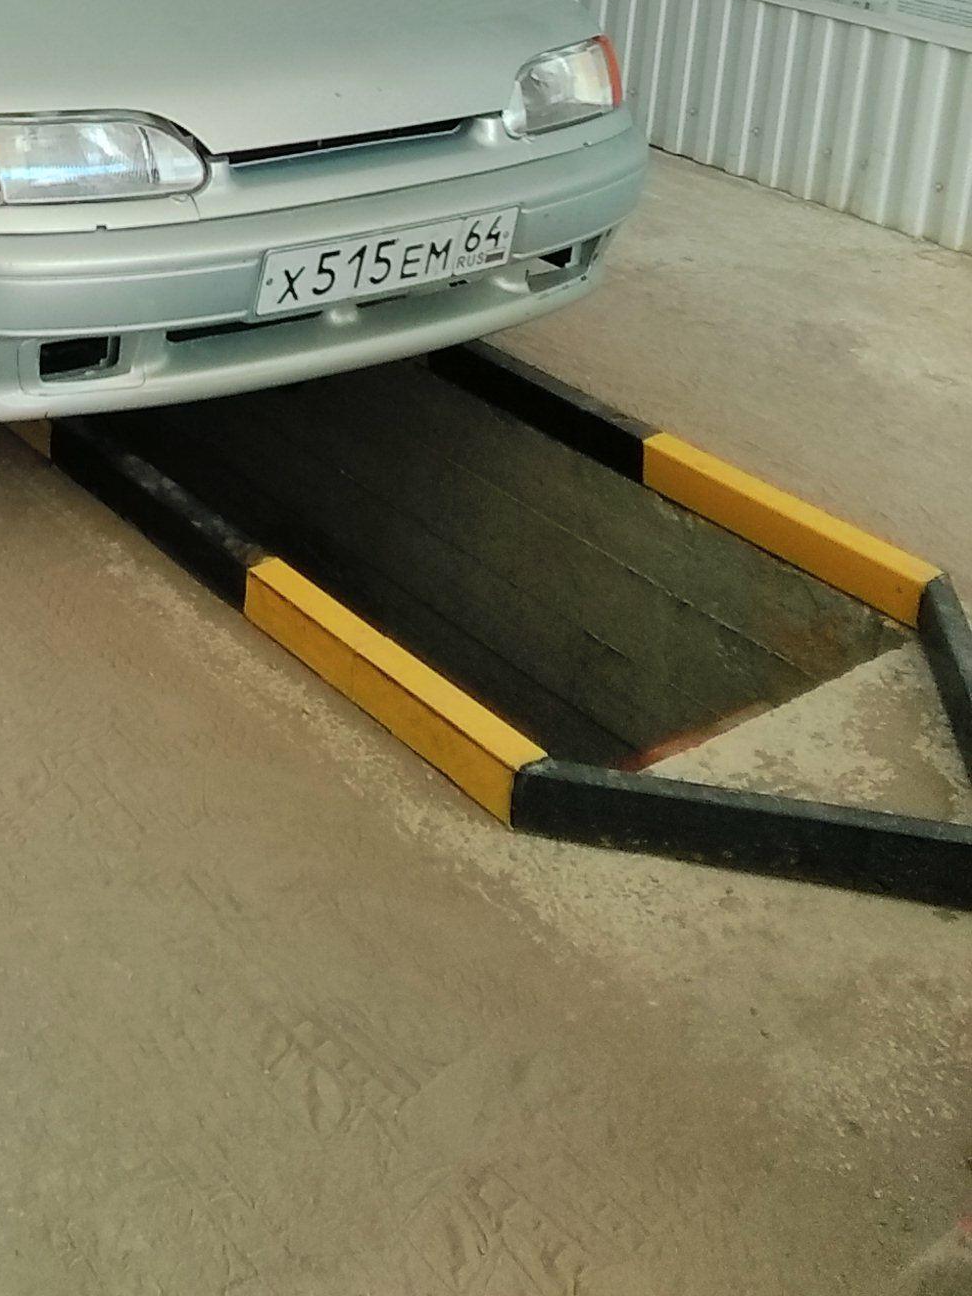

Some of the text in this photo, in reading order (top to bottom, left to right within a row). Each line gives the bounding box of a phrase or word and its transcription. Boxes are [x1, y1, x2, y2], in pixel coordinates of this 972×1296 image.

[277, 215, 504, 305] Х515ЕМ 64
[456, 254, 485, 269] RUS
